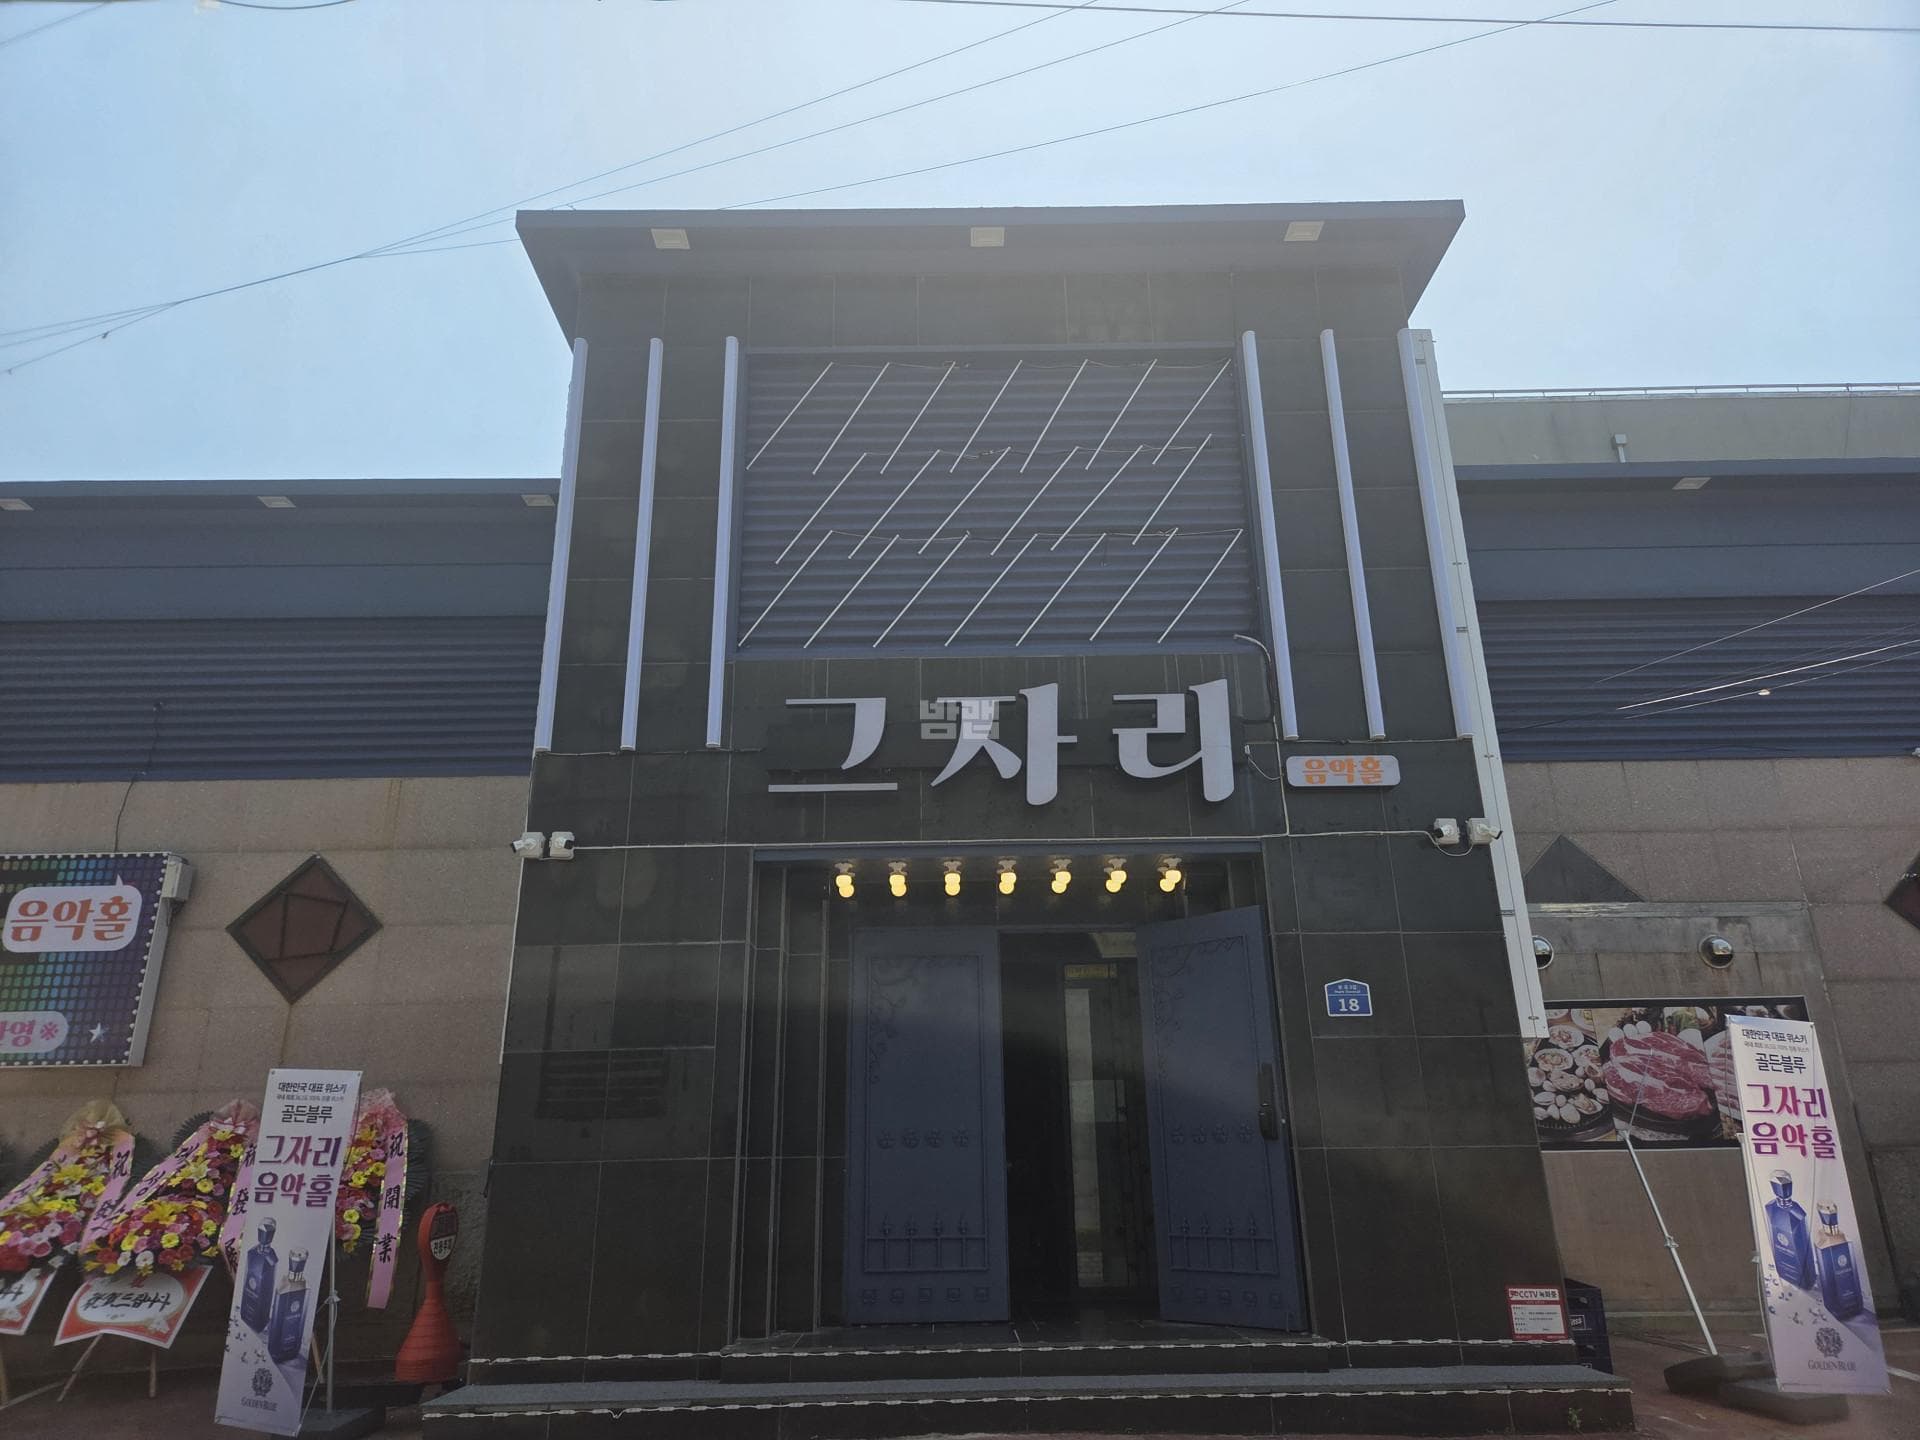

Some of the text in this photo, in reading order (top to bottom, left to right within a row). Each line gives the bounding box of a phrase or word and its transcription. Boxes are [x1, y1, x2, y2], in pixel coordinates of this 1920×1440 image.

[768, 679, 1235, 805] 그자리
[1302, 756, 1384, 785] 음악홀
[10, 895, 133, 943] 음악홀
[1338, 998, 1360, 1012] 18
[1741, 1028, 1808, 1044] 대한민국 대표 위스키
[1755, 1052, 1807, 1074] 골든블루
[278, 1082, 347, 1094] 대한민국 대표 위스키
[1746, 1084, 1828, 1118] 그자리
[281, 1104, 333, 1124] 골든블루
[258, 1135, 342, 1167] 그자리
[1751, 1121, 1836, 1159] 음악홀
[254, 1171, 334, 1208] 음악홀
[1519, 1290, 1538, 1298] CCTV
